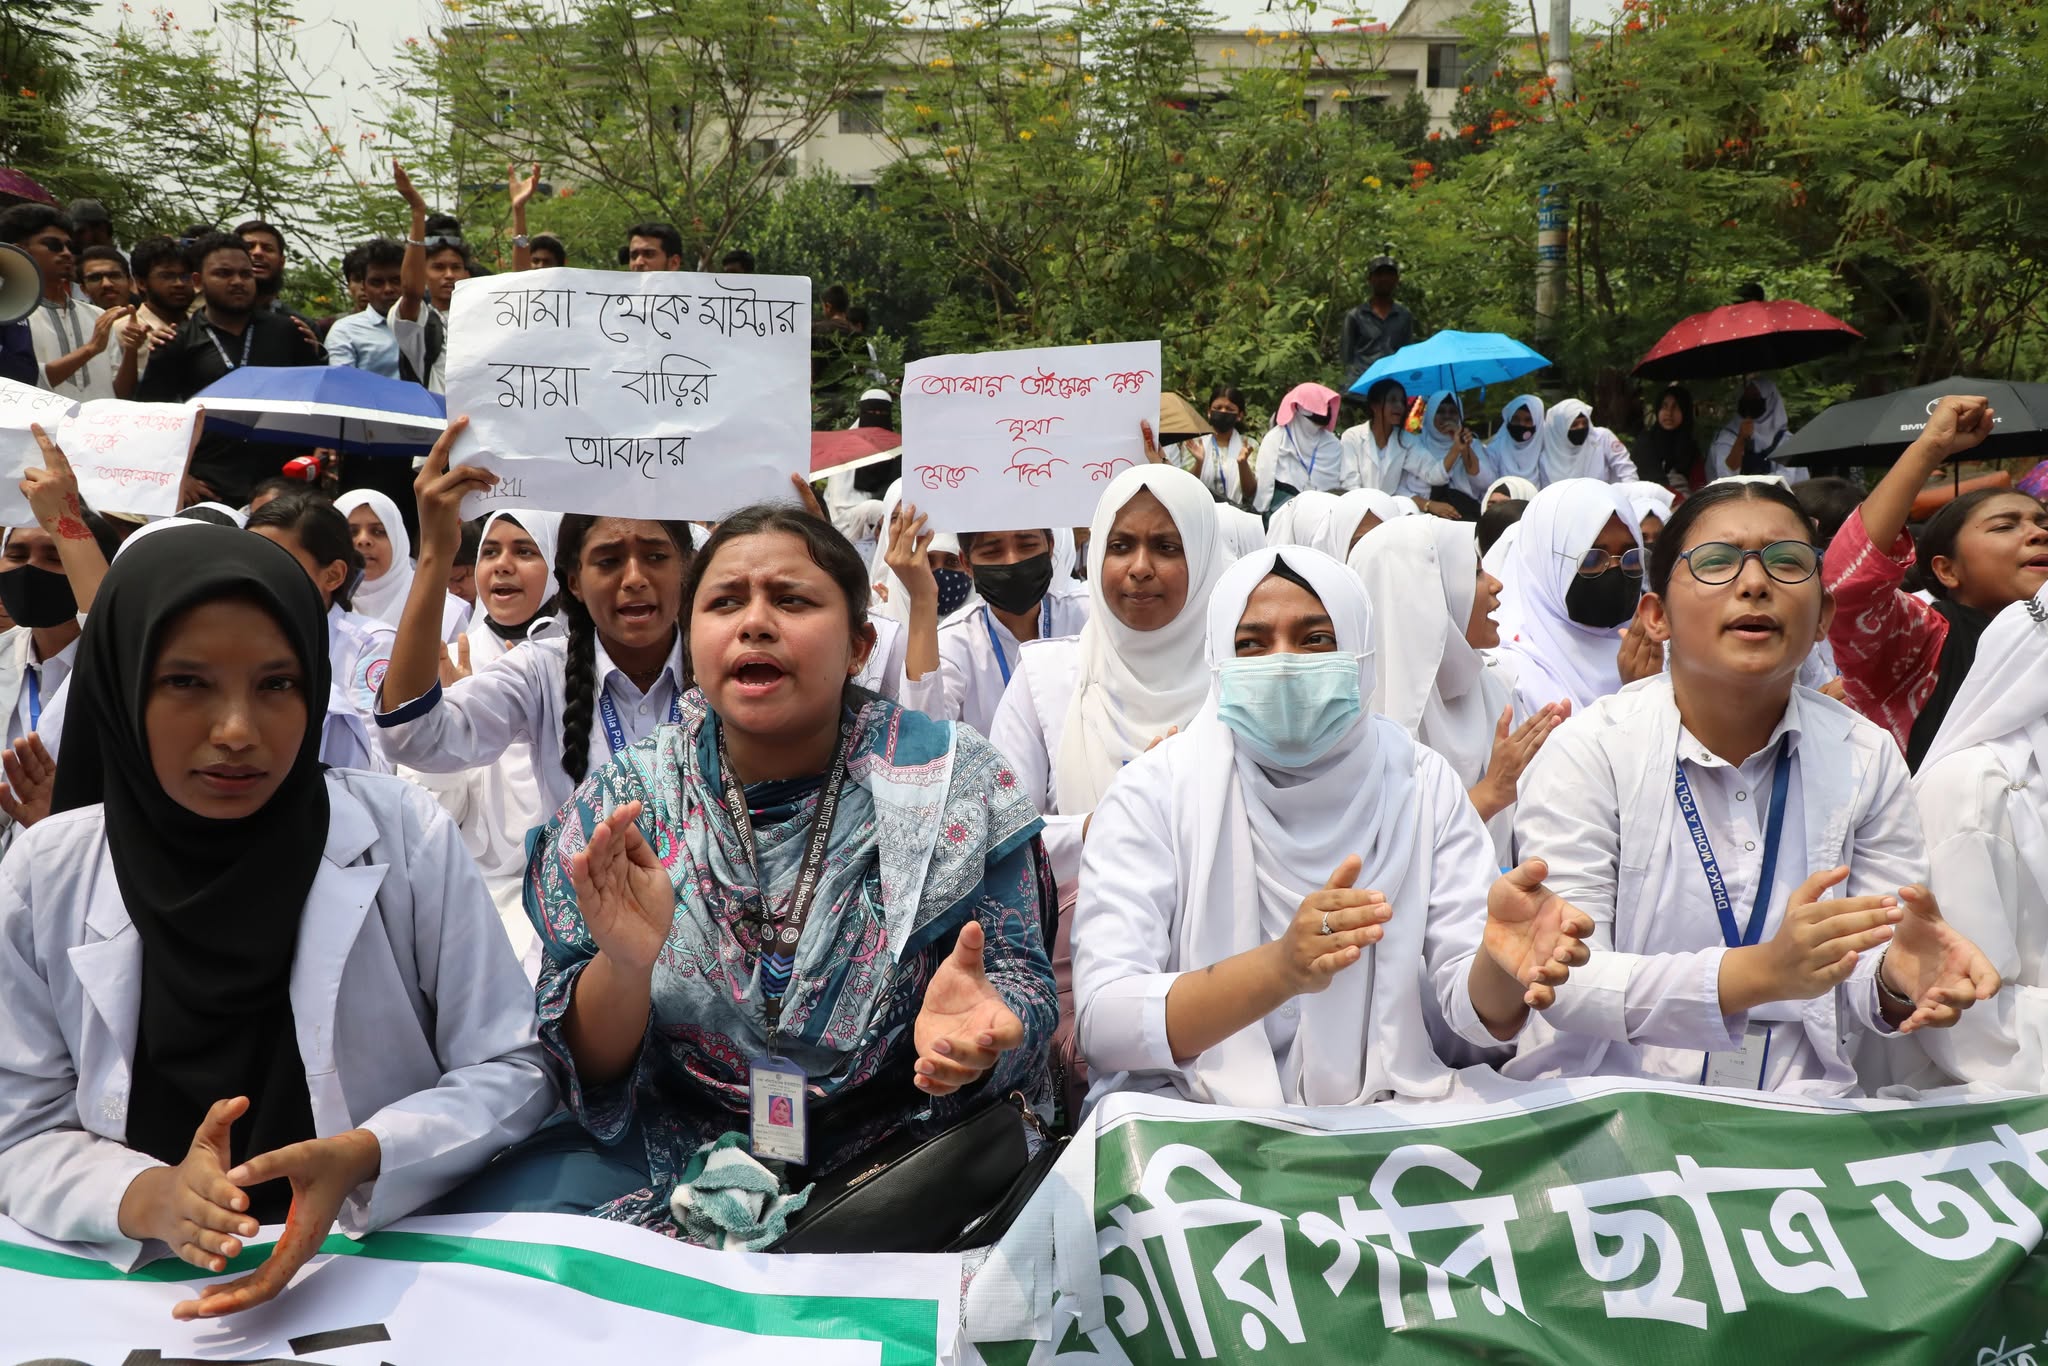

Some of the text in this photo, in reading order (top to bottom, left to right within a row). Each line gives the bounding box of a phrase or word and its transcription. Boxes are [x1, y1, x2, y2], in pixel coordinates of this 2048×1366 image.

[488, 288, 577, 330] মামা
[585, 291, 692, 343] থেকে
[488, 353, 717, 410] মামা বাড়ির
[908, 374, 1015, 398] আমার
[995, 416, 1065, 442] বৃথা
[565, 436, 691, 480] আবদার
[914, 464, 980, 490] যেতে
[600, 694, 617, 728] Mohila
[1687, 813, 1713, 863] MOHILA
[789, 881, 813, 924] (Mechanical)
[1707, 863, 1729, 910] DHAKA
[1547, 1155, 1868, 1330] ছাত্র
